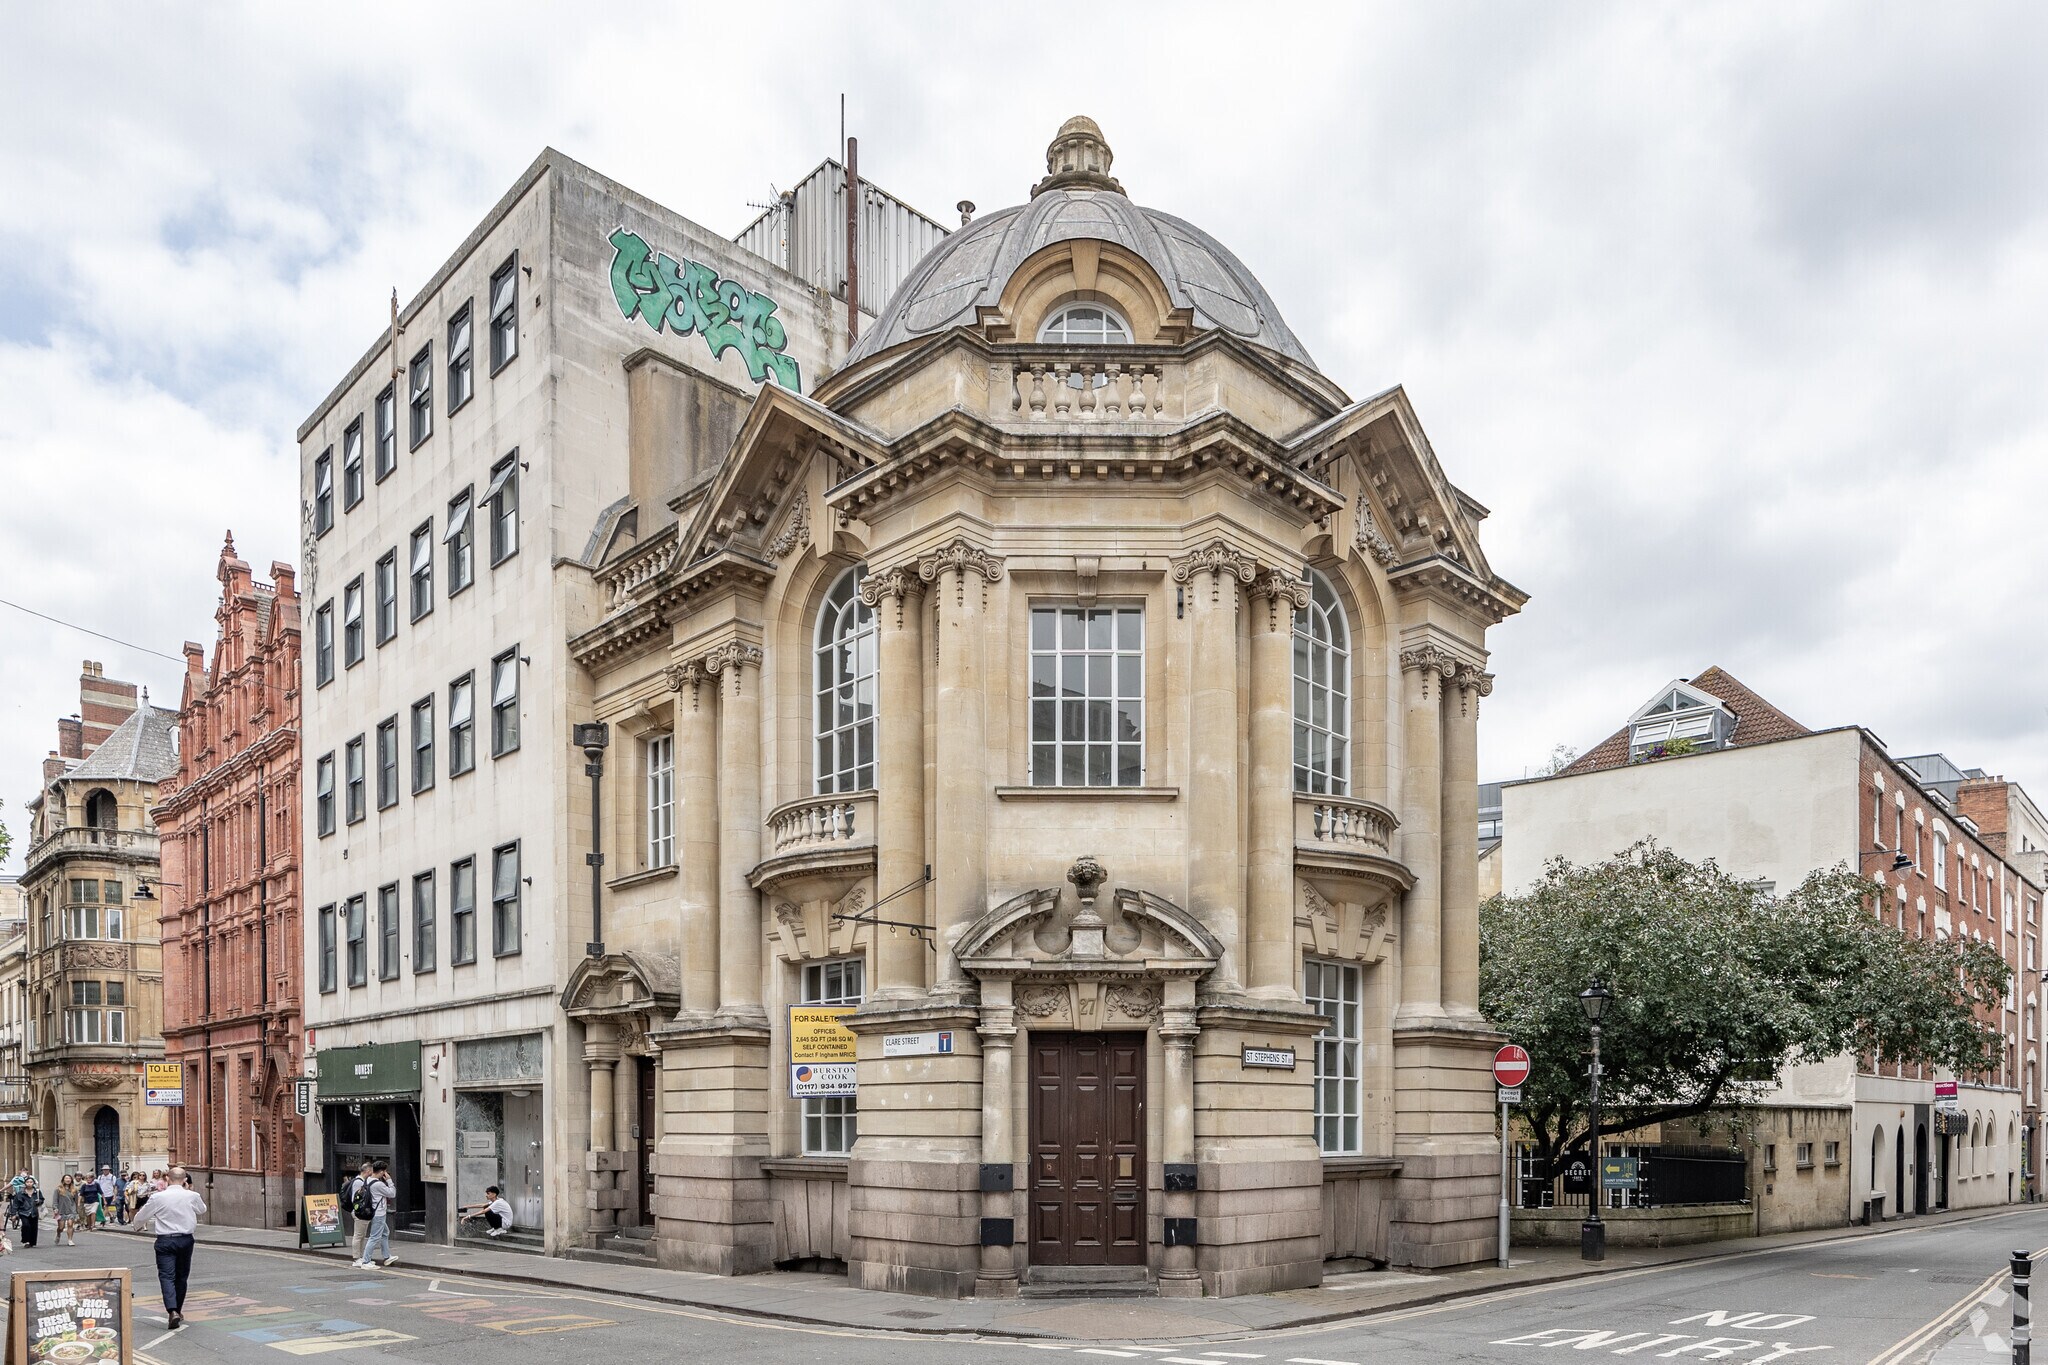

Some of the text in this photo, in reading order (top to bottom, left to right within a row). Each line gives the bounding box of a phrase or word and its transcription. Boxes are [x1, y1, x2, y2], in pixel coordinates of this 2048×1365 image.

[1080, 998, 1096, 1015] 27
[885, 1036, 920, 1047] CLARE STREET
[1247, 1052, 1253, 1061] ST
[1255, 1052, 1280, 1063] STEPHENS
[1281, 1054, 1288, 1063] ST
[354, 1064, 373, 1075] HONEST
[300, 1085, 308, 1112] HONEST
[122, 1162, 130, 1170] 15
[35, 1288, 76, 1302] NOODLE
[36, 1297, 77, 1311] SOUPS
[82, 1298, 109, 1309] RICE
[76, 1307, 113, 1319] BOWLS
[1668, 1310, 1817, 1330] NO
[37, 1313, 71, 1328] FRESH
[36, 1322, 77, 1338] JUICES
[1488, 1328, 1835, 1365] ENTRY
